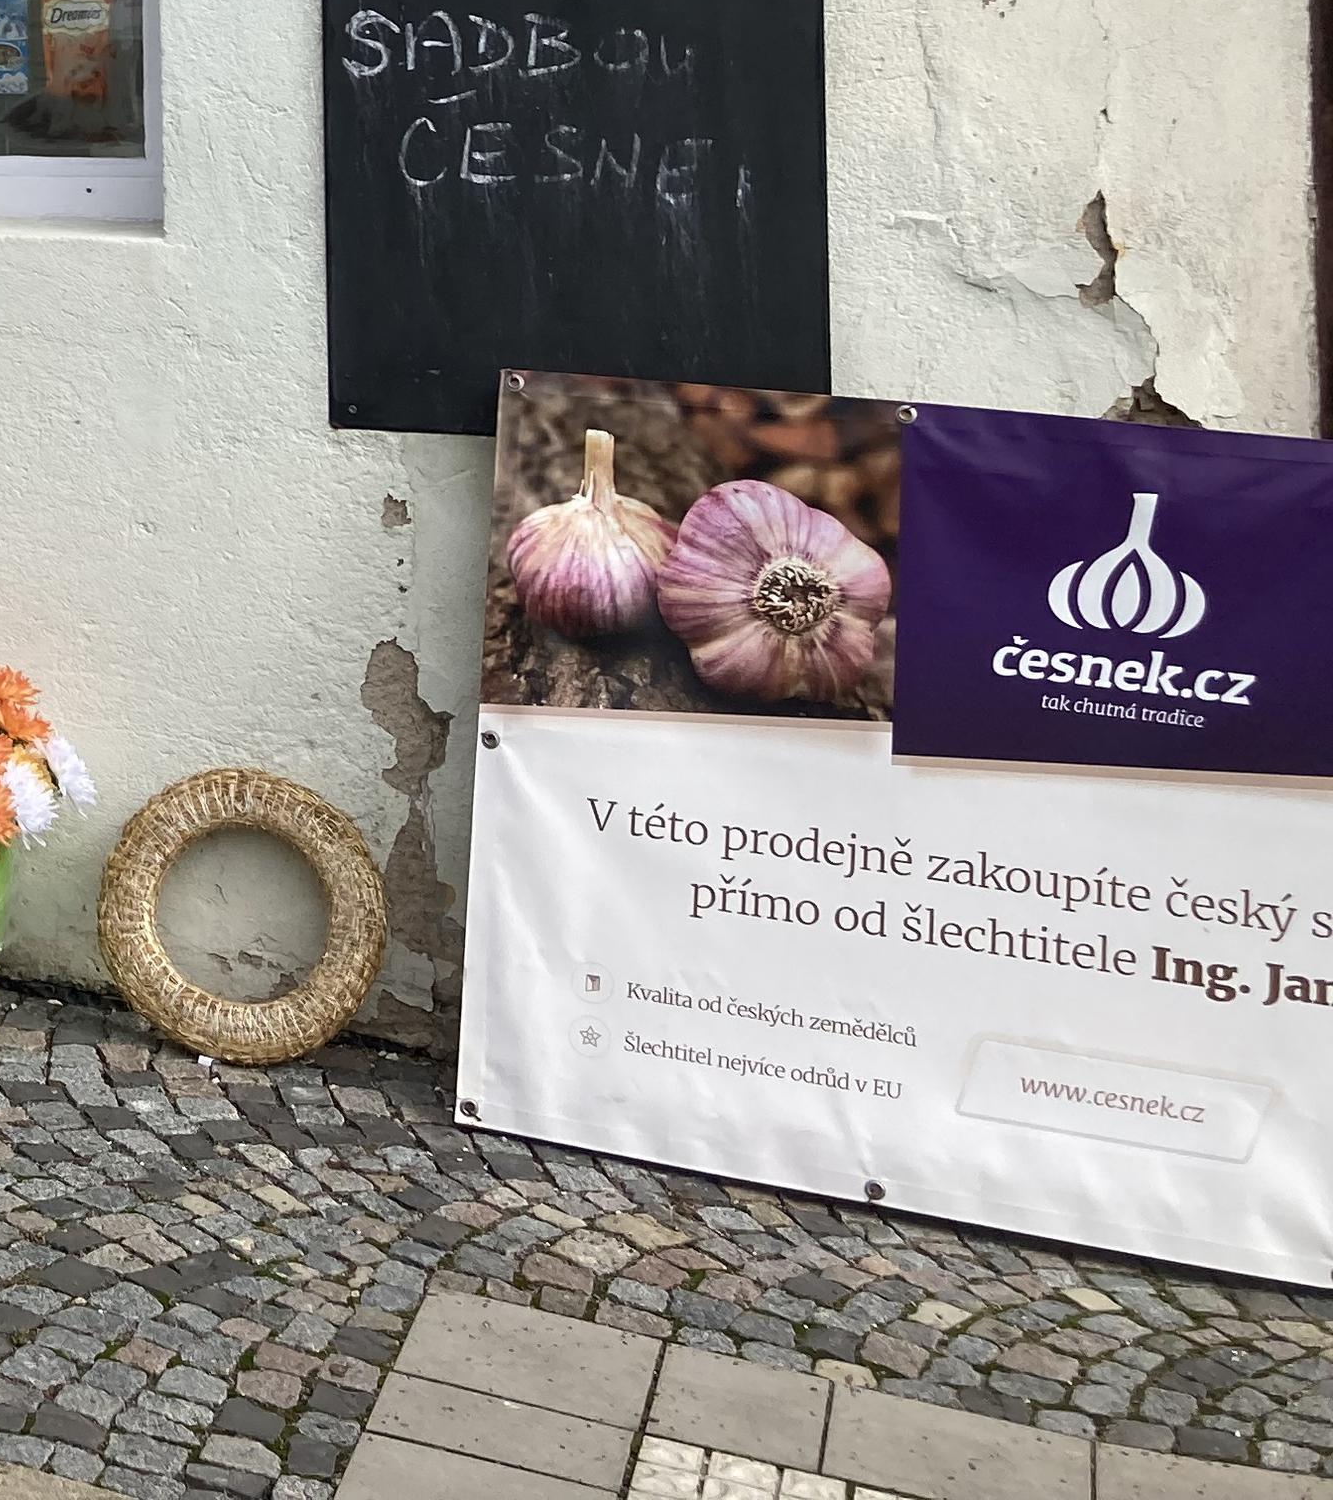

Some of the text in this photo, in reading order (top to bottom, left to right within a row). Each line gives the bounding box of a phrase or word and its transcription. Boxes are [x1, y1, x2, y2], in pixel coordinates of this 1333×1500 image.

[992, 636, 1257, 706] česnek.cz
[1041, 695, 1205, 729] tak chutná tradice
[587, 797, 618, 831] V
[629, 803, 710, 848] této
[722, 820, 913, 878] prodejně
[927, 850, 1152, 912] zakoupíte
[1166, 876, 1298, 942] český
[689, 874, 821, 926] přímo
[834, 902, 888, 938] od
[900, 902, 1139, 978] šlechtitele
[1150, 946, 1251, 1002] Ing.
[625, 981, 918, 1049] Kvalita od českých zemědělců
[623, 1030, 903, 1100] Šlechtitel nejvíce odrůd v EU
[1019, 1072, 1206, 1125] www.cesnek.cz
